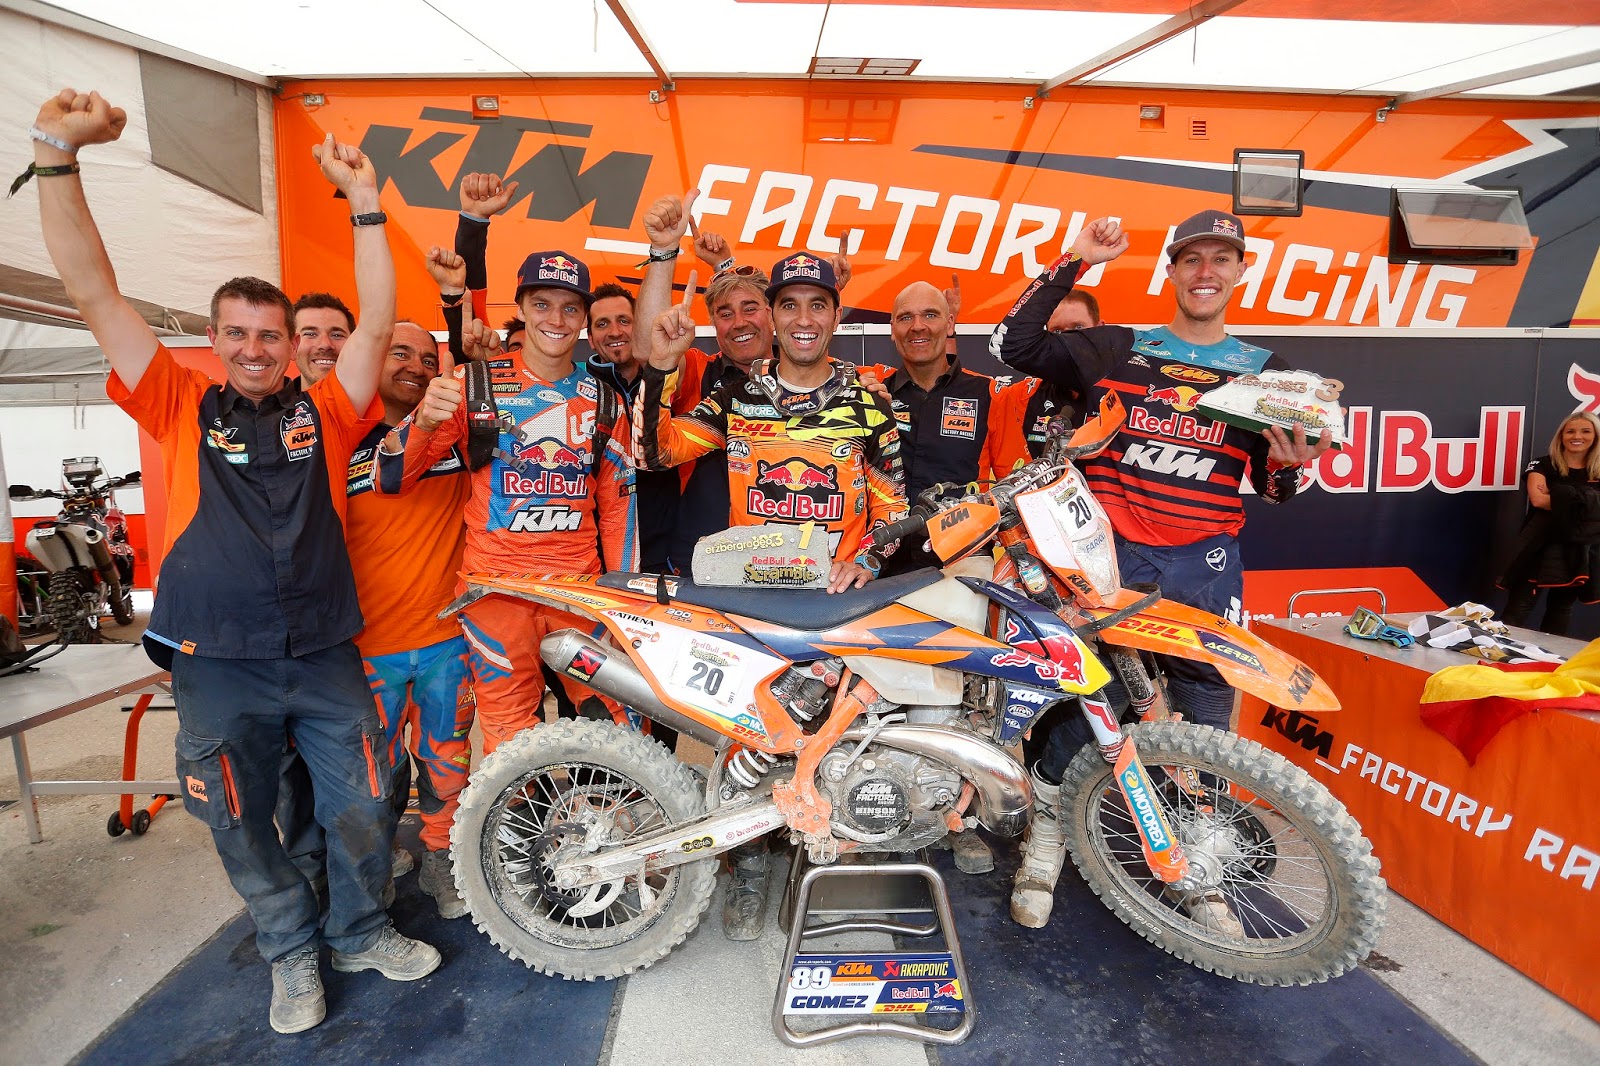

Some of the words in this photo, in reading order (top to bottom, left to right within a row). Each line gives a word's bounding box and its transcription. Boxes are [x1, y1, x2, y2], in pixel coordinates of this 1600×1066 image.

[333, 106, 653, 230] KTM
[539, 268, 560, 280] Red
[560, 270, 579, 286] Bull
[783, 268, 801, 281] Red
[801, 266, 821, 280] Bull
[1161, 365, 1220, 383] FMF
[1265, 393, 1283, 404] Red
[1282, 397, 1298, 409] Bull
[1315, 378, 1344, 402] 3
[730, 418, 778, 438] DHL
[947, 419, 970, 428] KTM
[1129, 406, 1179, 436] Red
[1177, 415, 1227, 446] Bull
[291, 431, 315, 443] KTM
[1376, 405, 1526, 493] Bull
[1120, 440, 1217, 482] KTM
[504, 471, 547, 495] Red
[549, 472, 588, 497] Bull
[749, 489, 794, 518] Red
[796, 493, 842, 520] Bull
[1067, 495, 1093, 530] 20
[509, 506, 582, 532] KTM
[940, 507, 970, 532] KTM
[798, 520, 816, 550] 1
[743, 562, 817, 583] Scramble
[752, 556, 769, 566] Red
[769, 556, 786, 566] Bull
[1067, 573, 1092, 595] KTM
[615, 612, 654, 627] ATHENA
[1115, 618, 1186, 642] DHL
[691, 638, 706, 649] Red
[704, 643, 720, 654] Bull
[1205, 640, 1260, 668] ACERBIS
[686, 661, 725, 696] 20
[1287, 663, 1317, 705] KTM
[1260, 703, 1334, 760] KTM
[1341, 742, 1513, 839] FACTORY
[190, 782, 207, 797] KTM
[860, 783, 892, 794] KTM
[1131, 786, 1166, 848] MOTOREX
[736, 820, 770, 838] brembo
[791, 966, 832, 990] 89
[836, 962, 873, 976] KTM
[900, 961, 949, 977] AKRAPOVIČ
[790, 995, 869, 1009] GOMEZ
[891, 987, 911, 999] Red
[911, 986, 930, 999] Bull
[883, 1004, 916, 1012] DHL
